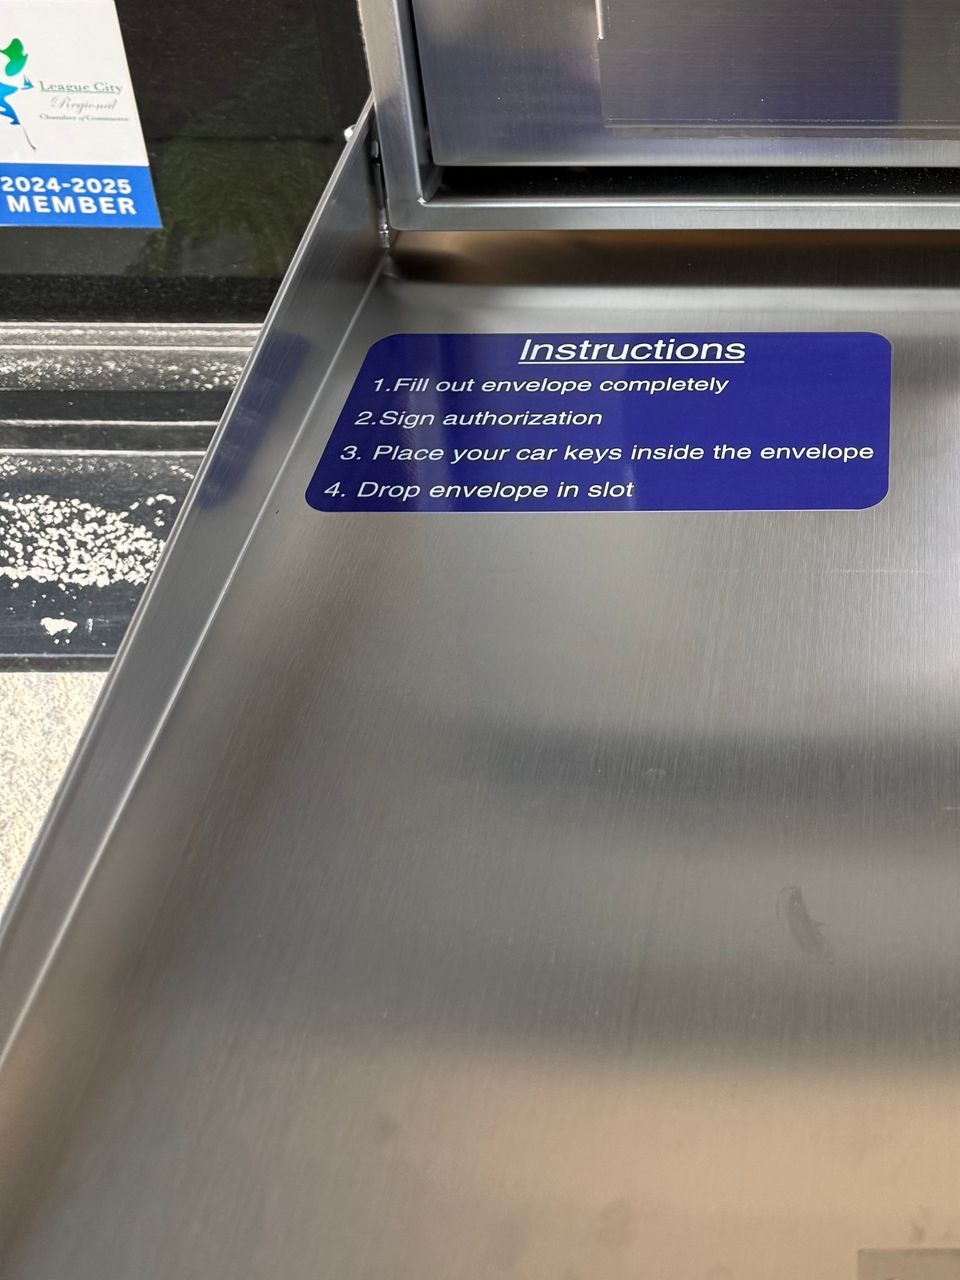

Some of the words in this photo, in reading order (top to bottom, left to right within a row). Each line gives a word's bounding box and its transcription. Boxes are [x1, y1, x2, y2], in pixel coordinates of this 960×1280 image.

[40, 81, 90, 94] League
[94, 81, 123, 95] City
[0, 176, 132, 194] 2024-2025
[6, 195, 137, 214] MEMBER
[519, 339, 746, 361] Instructions
[373, 378, 428, 392] 1.Fill
[435, 379, 475, 392] out
[481, 378, 592, 395] envelope
[600, 377, 729, 395] completely
[354, 410, 435, 429] 2.Sign
[443, 410, 602, 425] authorization
[340, 445, 361, 460] 3.
[373, 445, 444, 460] Place
[450, 448, 510, 464] your
[516, 448, 558, 460] car
[564, 445, 622, 464] keys
[631, 444, 705, 460] inside
[713, 444, 752, 459] the
[760, 444, 874, 462] envelope
[324, 482, 346, 497] 4.
[357, 481, 420, 501] Drop
[429, 481, 549, 501] envelope
[557, 481, 579, 497] in
[588, 481, 635, 497] slot
